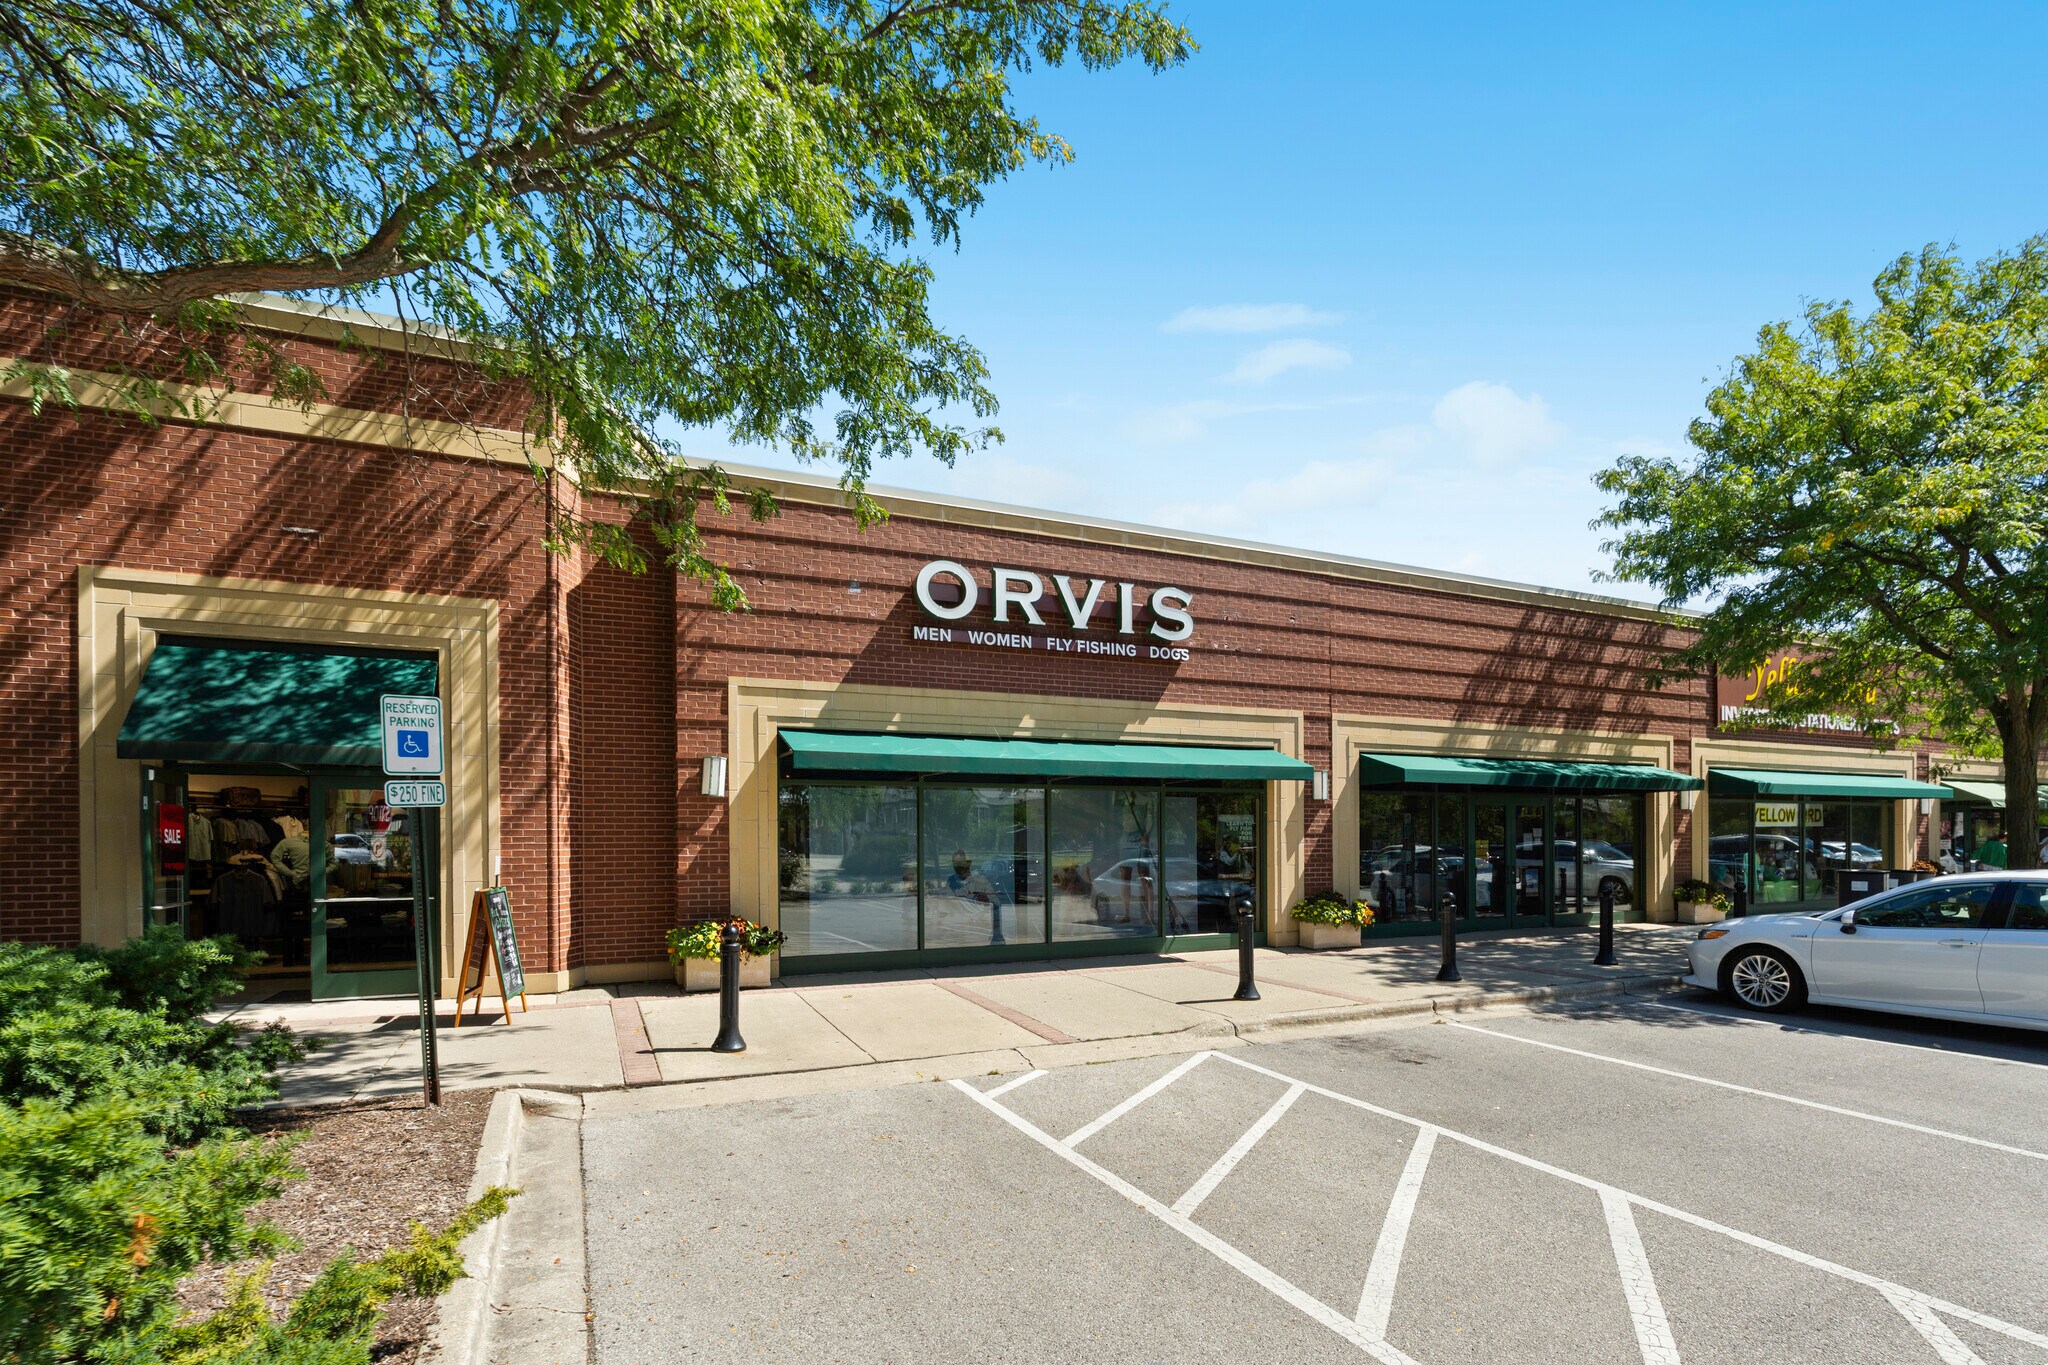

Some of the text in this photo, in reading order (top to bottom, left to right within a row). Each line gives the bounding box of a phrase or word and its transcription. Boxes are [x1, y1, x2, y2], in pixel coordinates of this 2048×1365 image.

[914, 559, 1194, 641] ORVIS
[913, 625, 1190, 661] MEN WOMEN FLY FISHING DOGS
[385, 702, 438, 715] RESERVED
[389, 716, 435, 728] PARKING
[390, 785, 442, 802] $250 FINE
[163, 828, 182, 844] SALE
